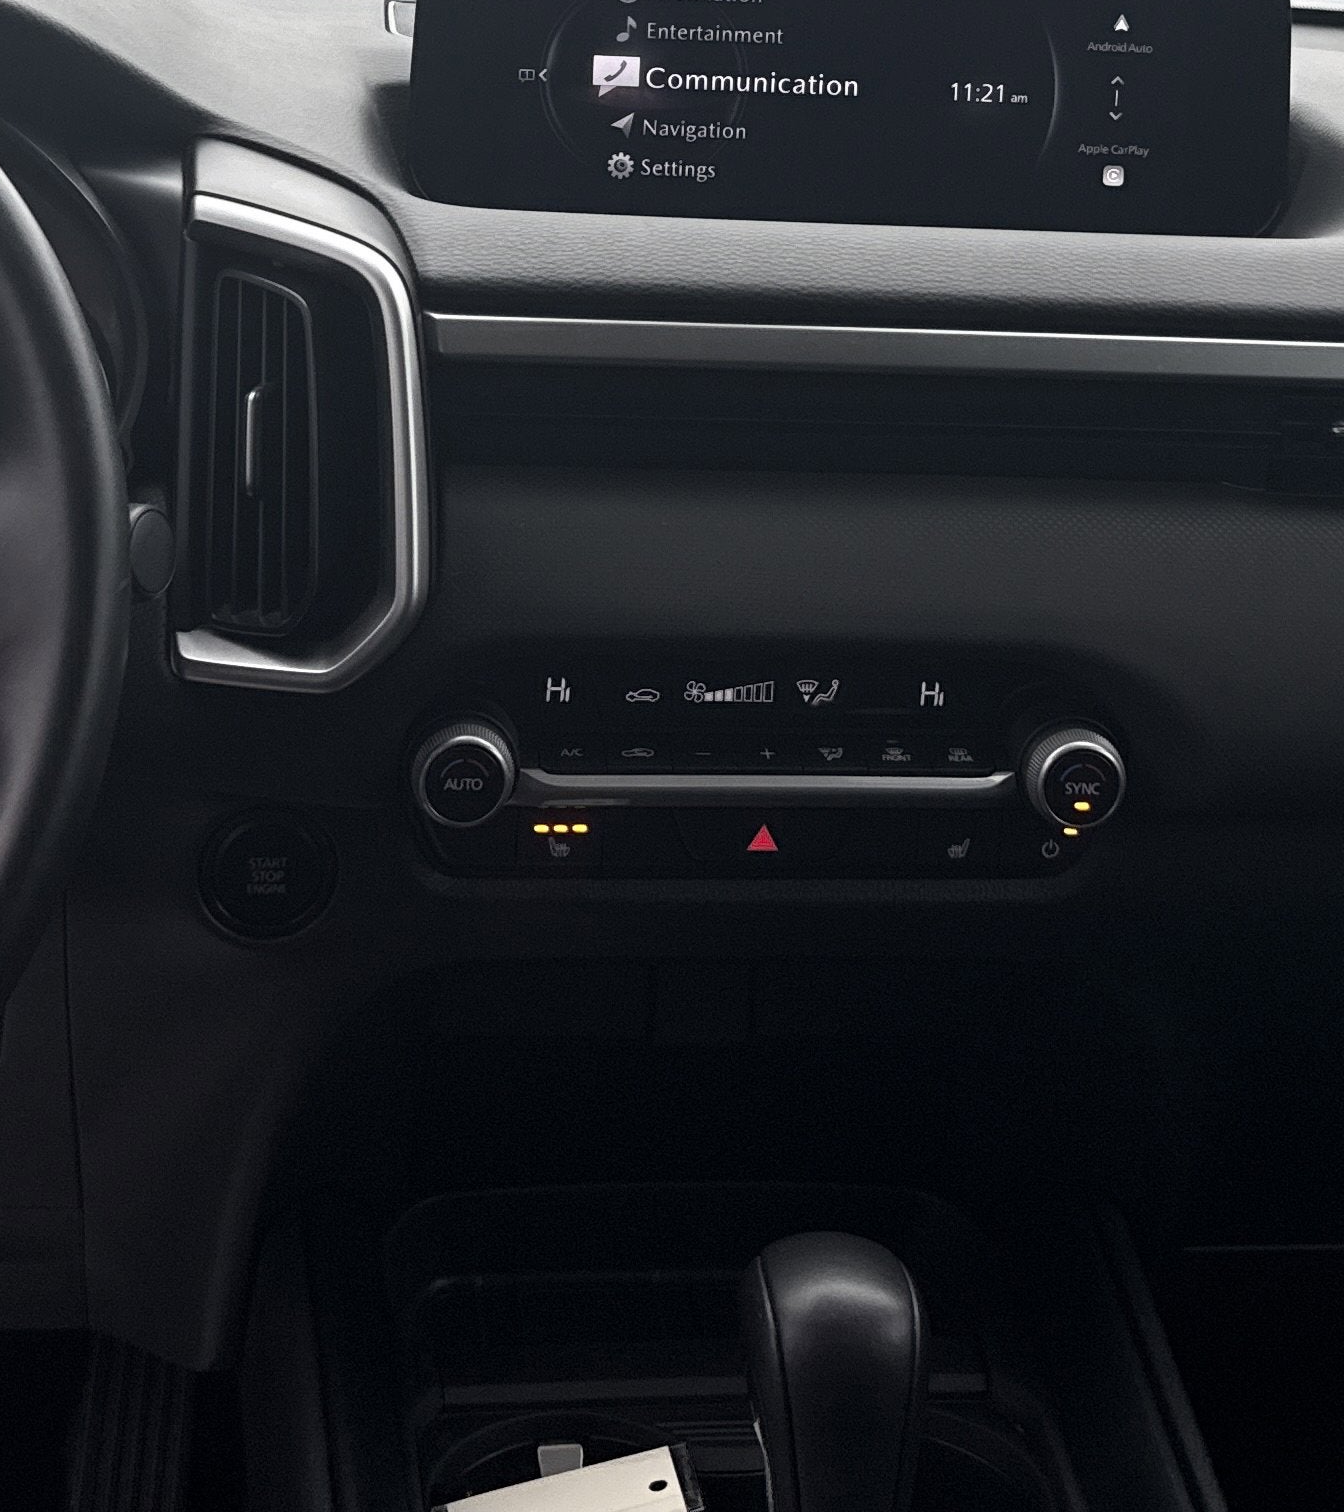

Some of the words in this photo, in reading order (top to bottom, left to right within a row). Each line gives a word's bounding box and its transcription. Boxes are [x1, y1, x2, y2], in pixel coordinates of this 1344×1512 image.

[647, 22, 784, 44] Entertainment
[1087, 41, 1126, 53] Android
[1128, 43, 1153, 54] Auto
[646, 67, 858, 96] Communication
[951, 82, 1004, 103] 11:21
[1010, 94, 1028, 104] am
[643, 120, 746, 142] Navigation
[1078, 143, 1109, 156] Apple
[1111, 145, 1150, 158] CarPlay
[640, 159, 716, 182] Settings
[560, 747, 584, 757] A/C
[443, 777, 484, 791] AUTO
[1064, 782, 1102, 795] SYNC
